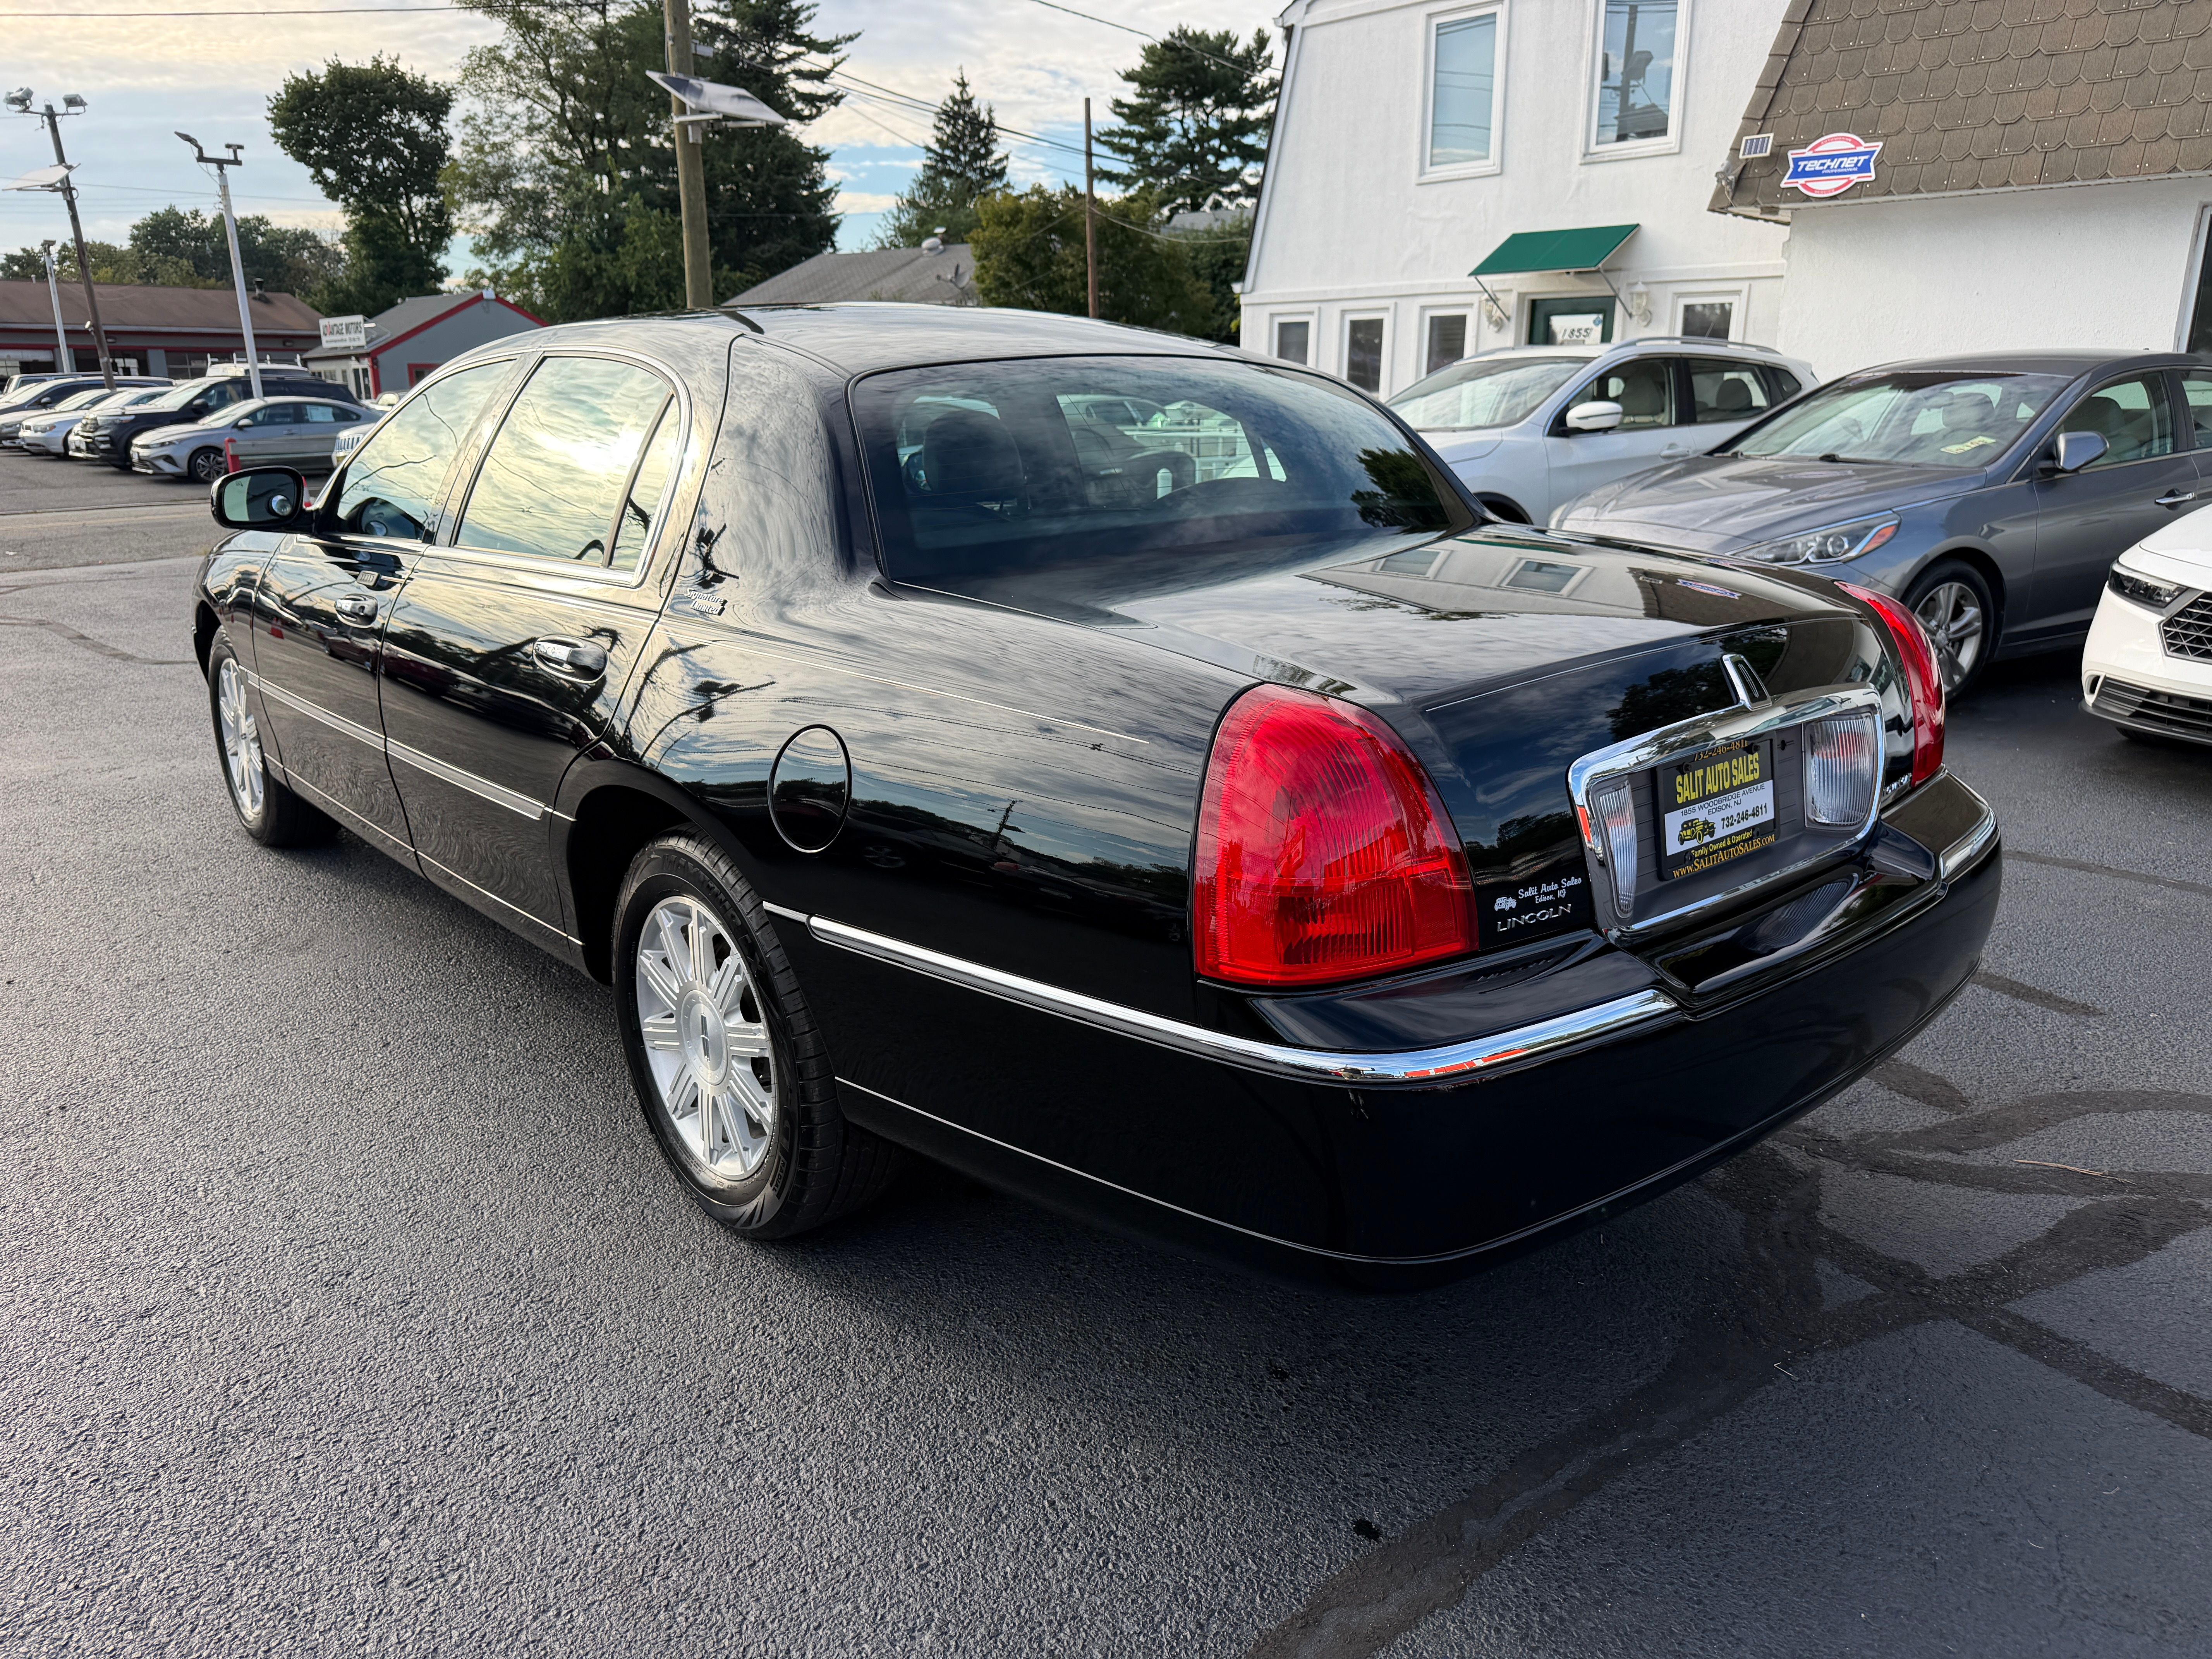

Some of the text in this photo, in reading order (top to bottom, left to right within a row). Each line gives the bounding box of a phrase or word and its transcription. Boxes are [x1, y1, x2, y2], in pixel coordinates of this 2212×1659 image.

[1797, 155, 1869, 172] TECHNET
[345, 321, 362, 335] MOTORS
[684, 588, 724, 604] Signature
[1676, 752, 1759, 804] SALIT AUTO SALES
[1681, 783, 1765, 817] 1855 WOODBRIDGE AVENUE
[1708, 802, 1732, 815] EDISON,
[1721, 802, 1767, 830] 732-246-4811
[1691, 846, 1708, 857] Family
[1709, 840, 1726, 852] Owned
[1731, 829, 1753, 844] Operated
[1518, 876, 1582, 899] Salit Auto Sales
[1535, 888, 1566, 903] Edison, NJ
[1497, 904, 1571, 932] LINCOLN
[772, 1159, 786, 1192] RADIAL
